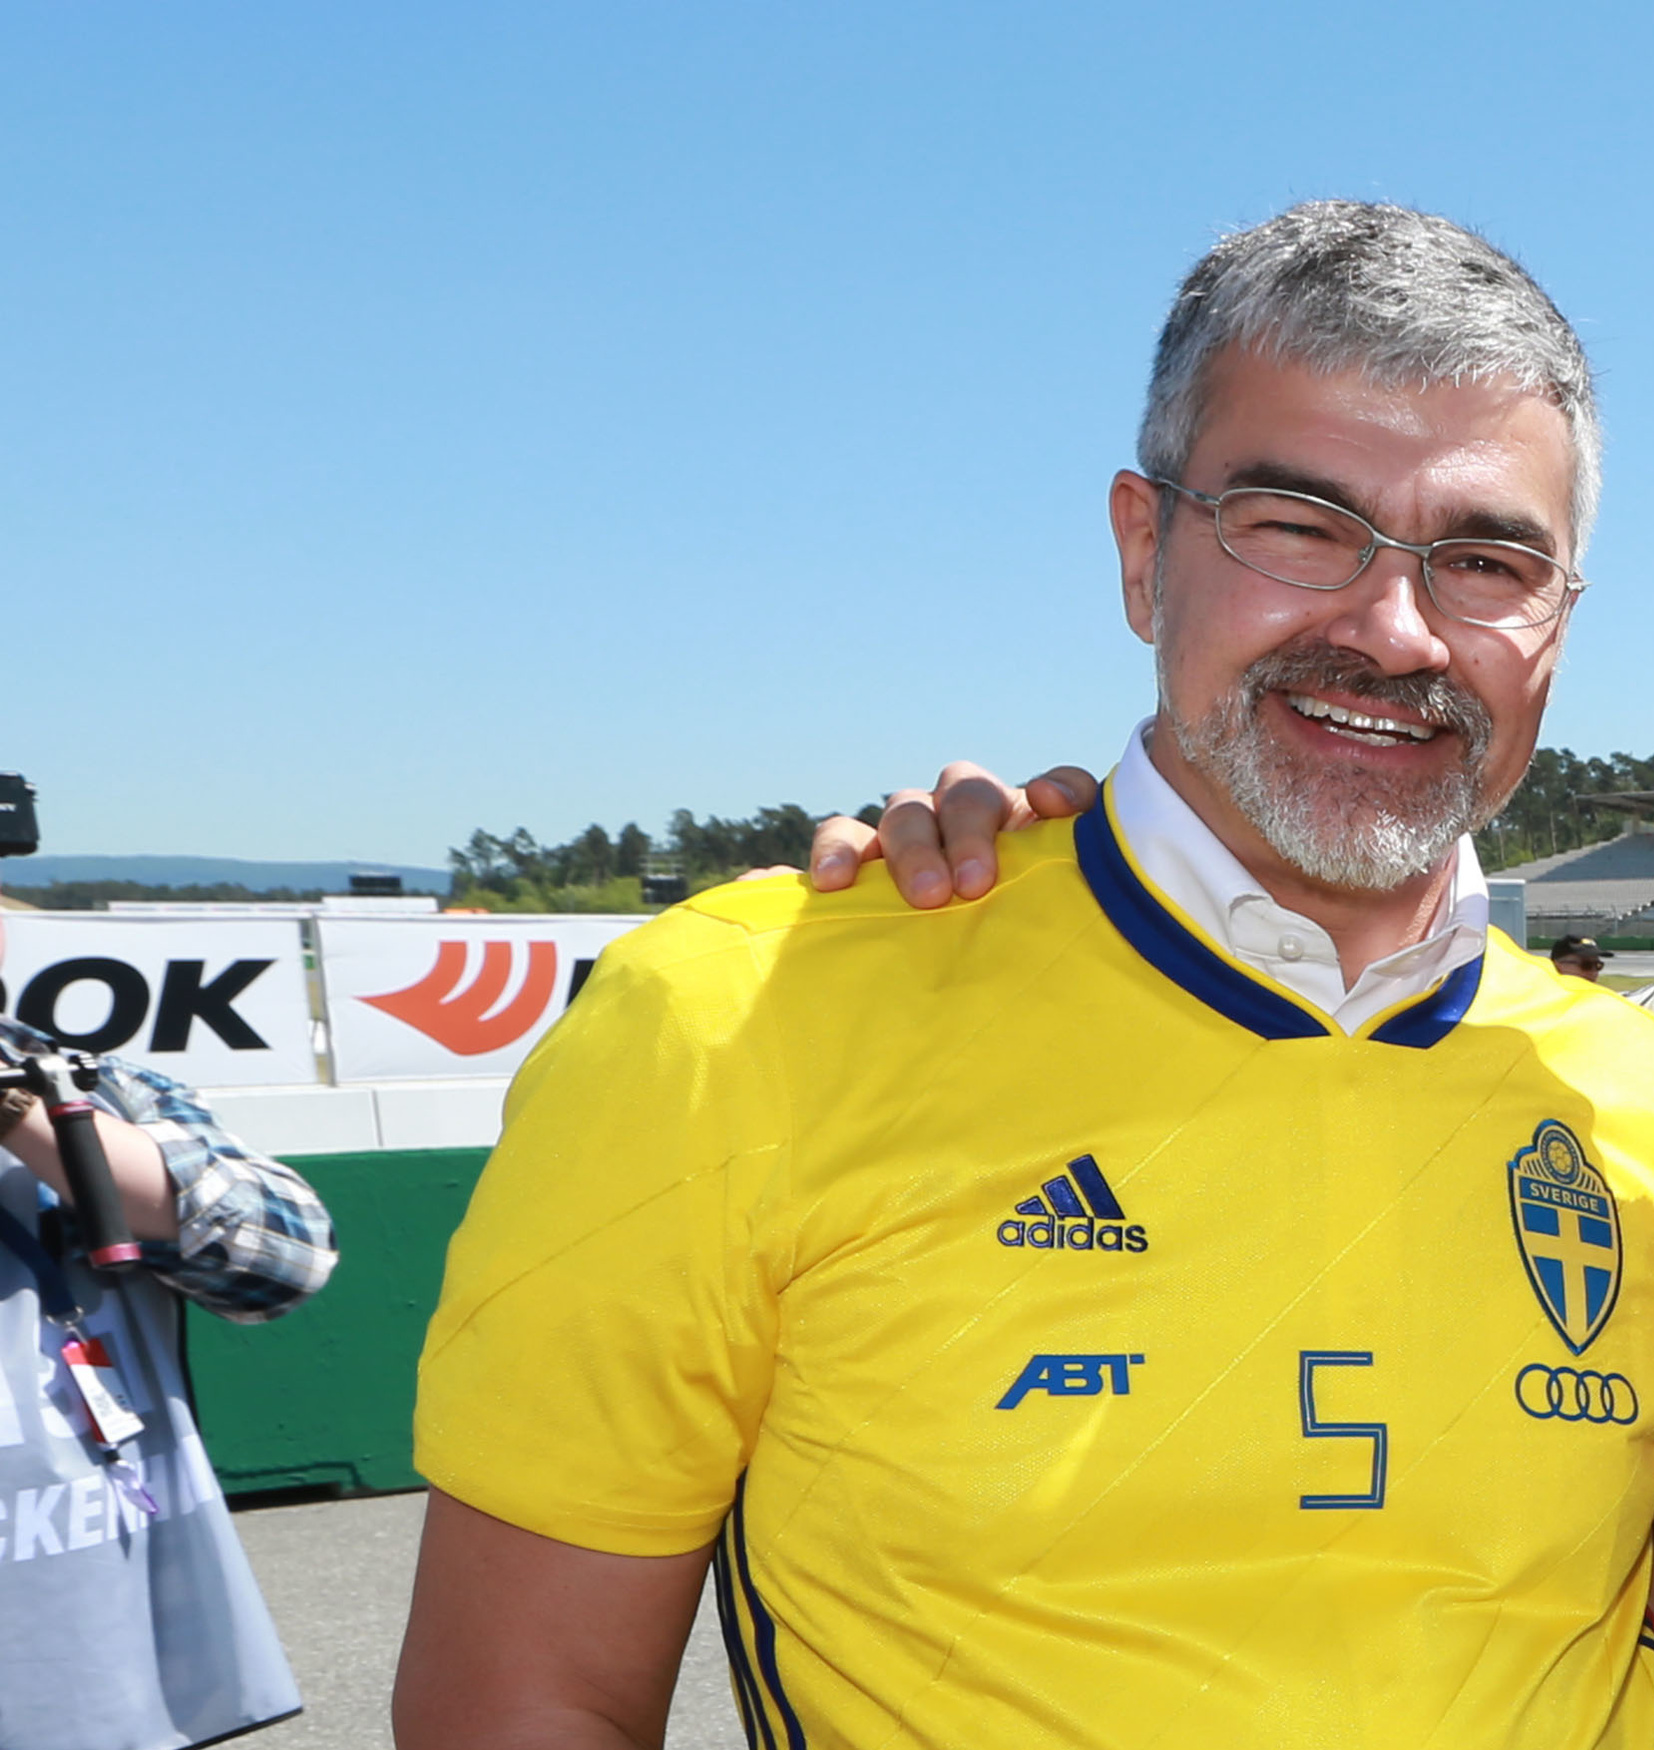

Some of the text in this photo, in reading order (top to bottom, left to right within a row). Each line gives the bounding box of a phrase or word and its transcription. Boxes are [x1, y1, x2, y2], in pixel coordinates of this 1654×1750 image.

[1529, 1181, 1601, 1214] SVERIGE
[997, 1214, 1149, 1254] adidas
[994, 1353, 1146, 1411] ABT
[1299, 1351, 1389, 1511] 5
